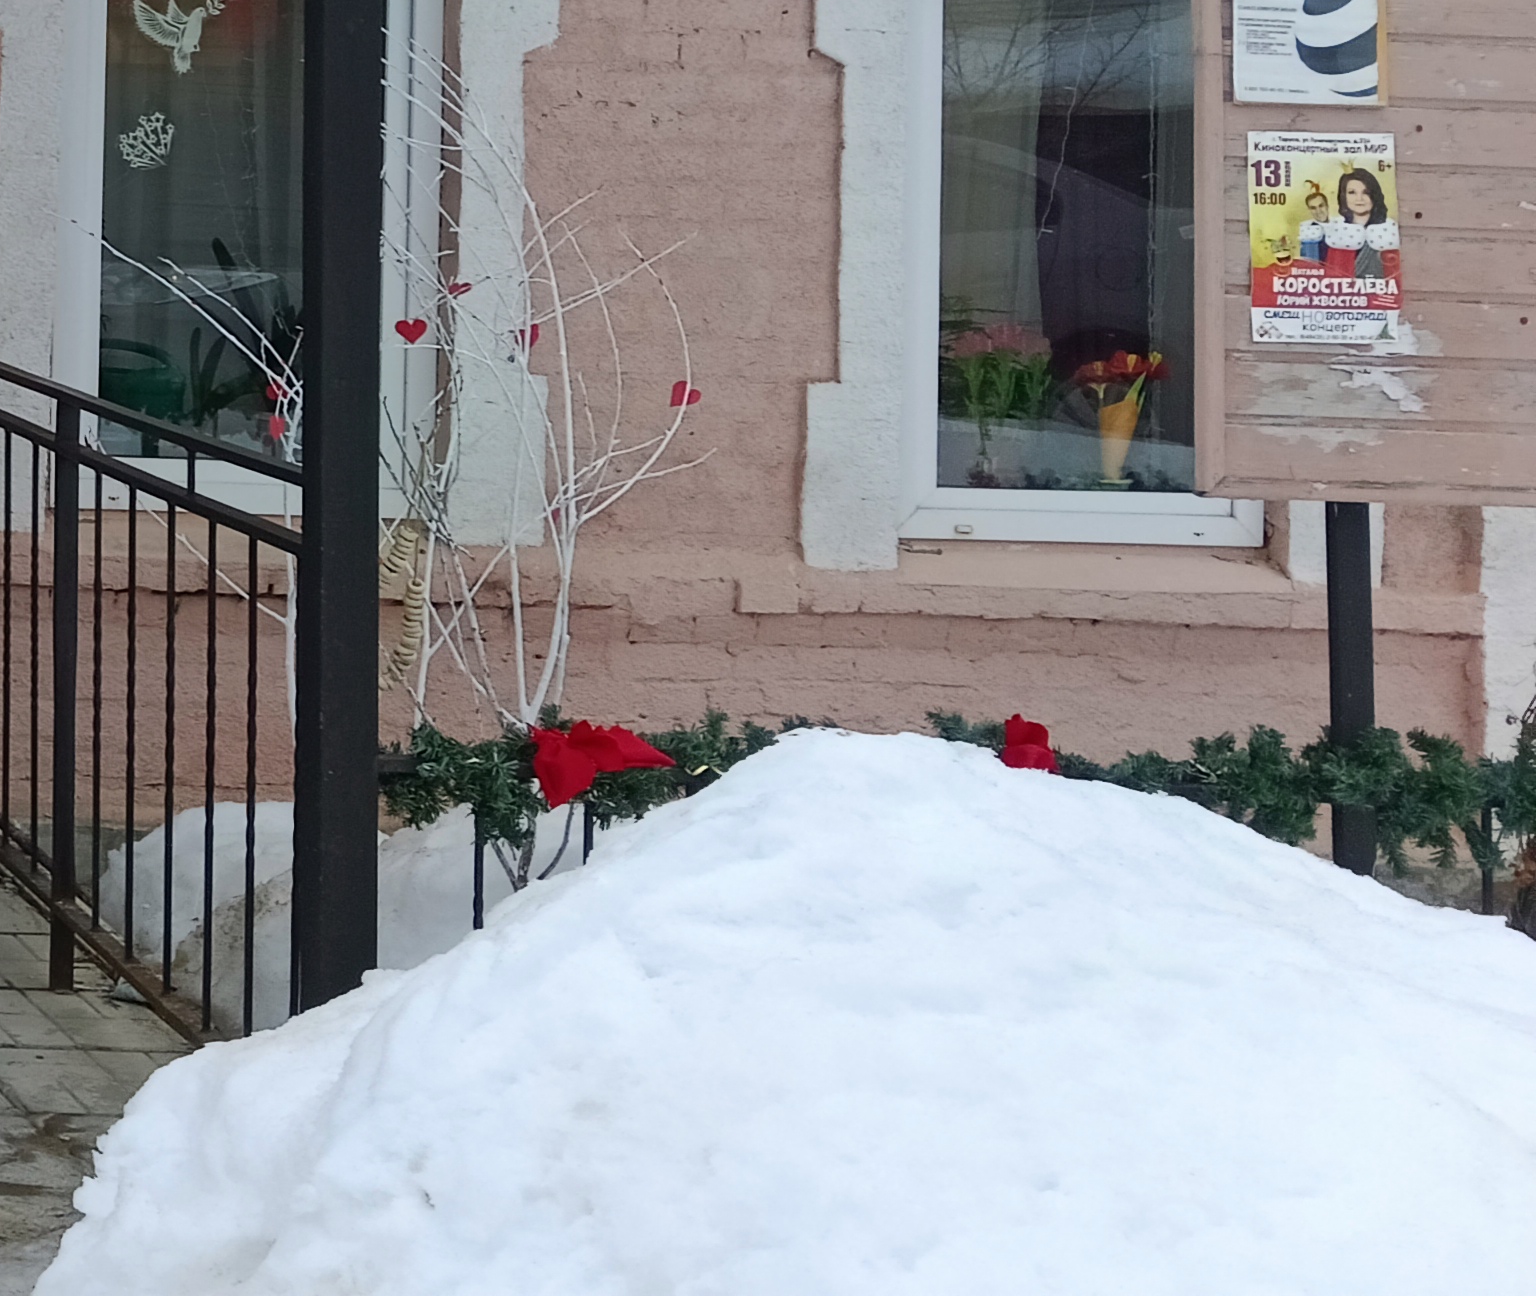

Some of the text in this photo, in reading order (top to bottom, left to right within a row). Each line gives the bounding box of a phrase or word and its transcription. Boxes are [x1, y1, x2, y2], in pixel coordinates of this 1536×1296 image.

[1253, 141, 1339, 155] Киноконцертный
[1343, 145, 1362, 154] зал
[1364, 143, 1388, 154] МИР
[1377, 159, 1392, 173] 6+
[1250, 159, 1282, 188] 13
[1253, 192, 1287, 206] 16:00
[1272, 274, 1399, 295] КОРОСТЕЛЁВА
[1311, 295, 1369, 307] ХВОСТОВ
[1302, 323, 1356, 333] концерт
